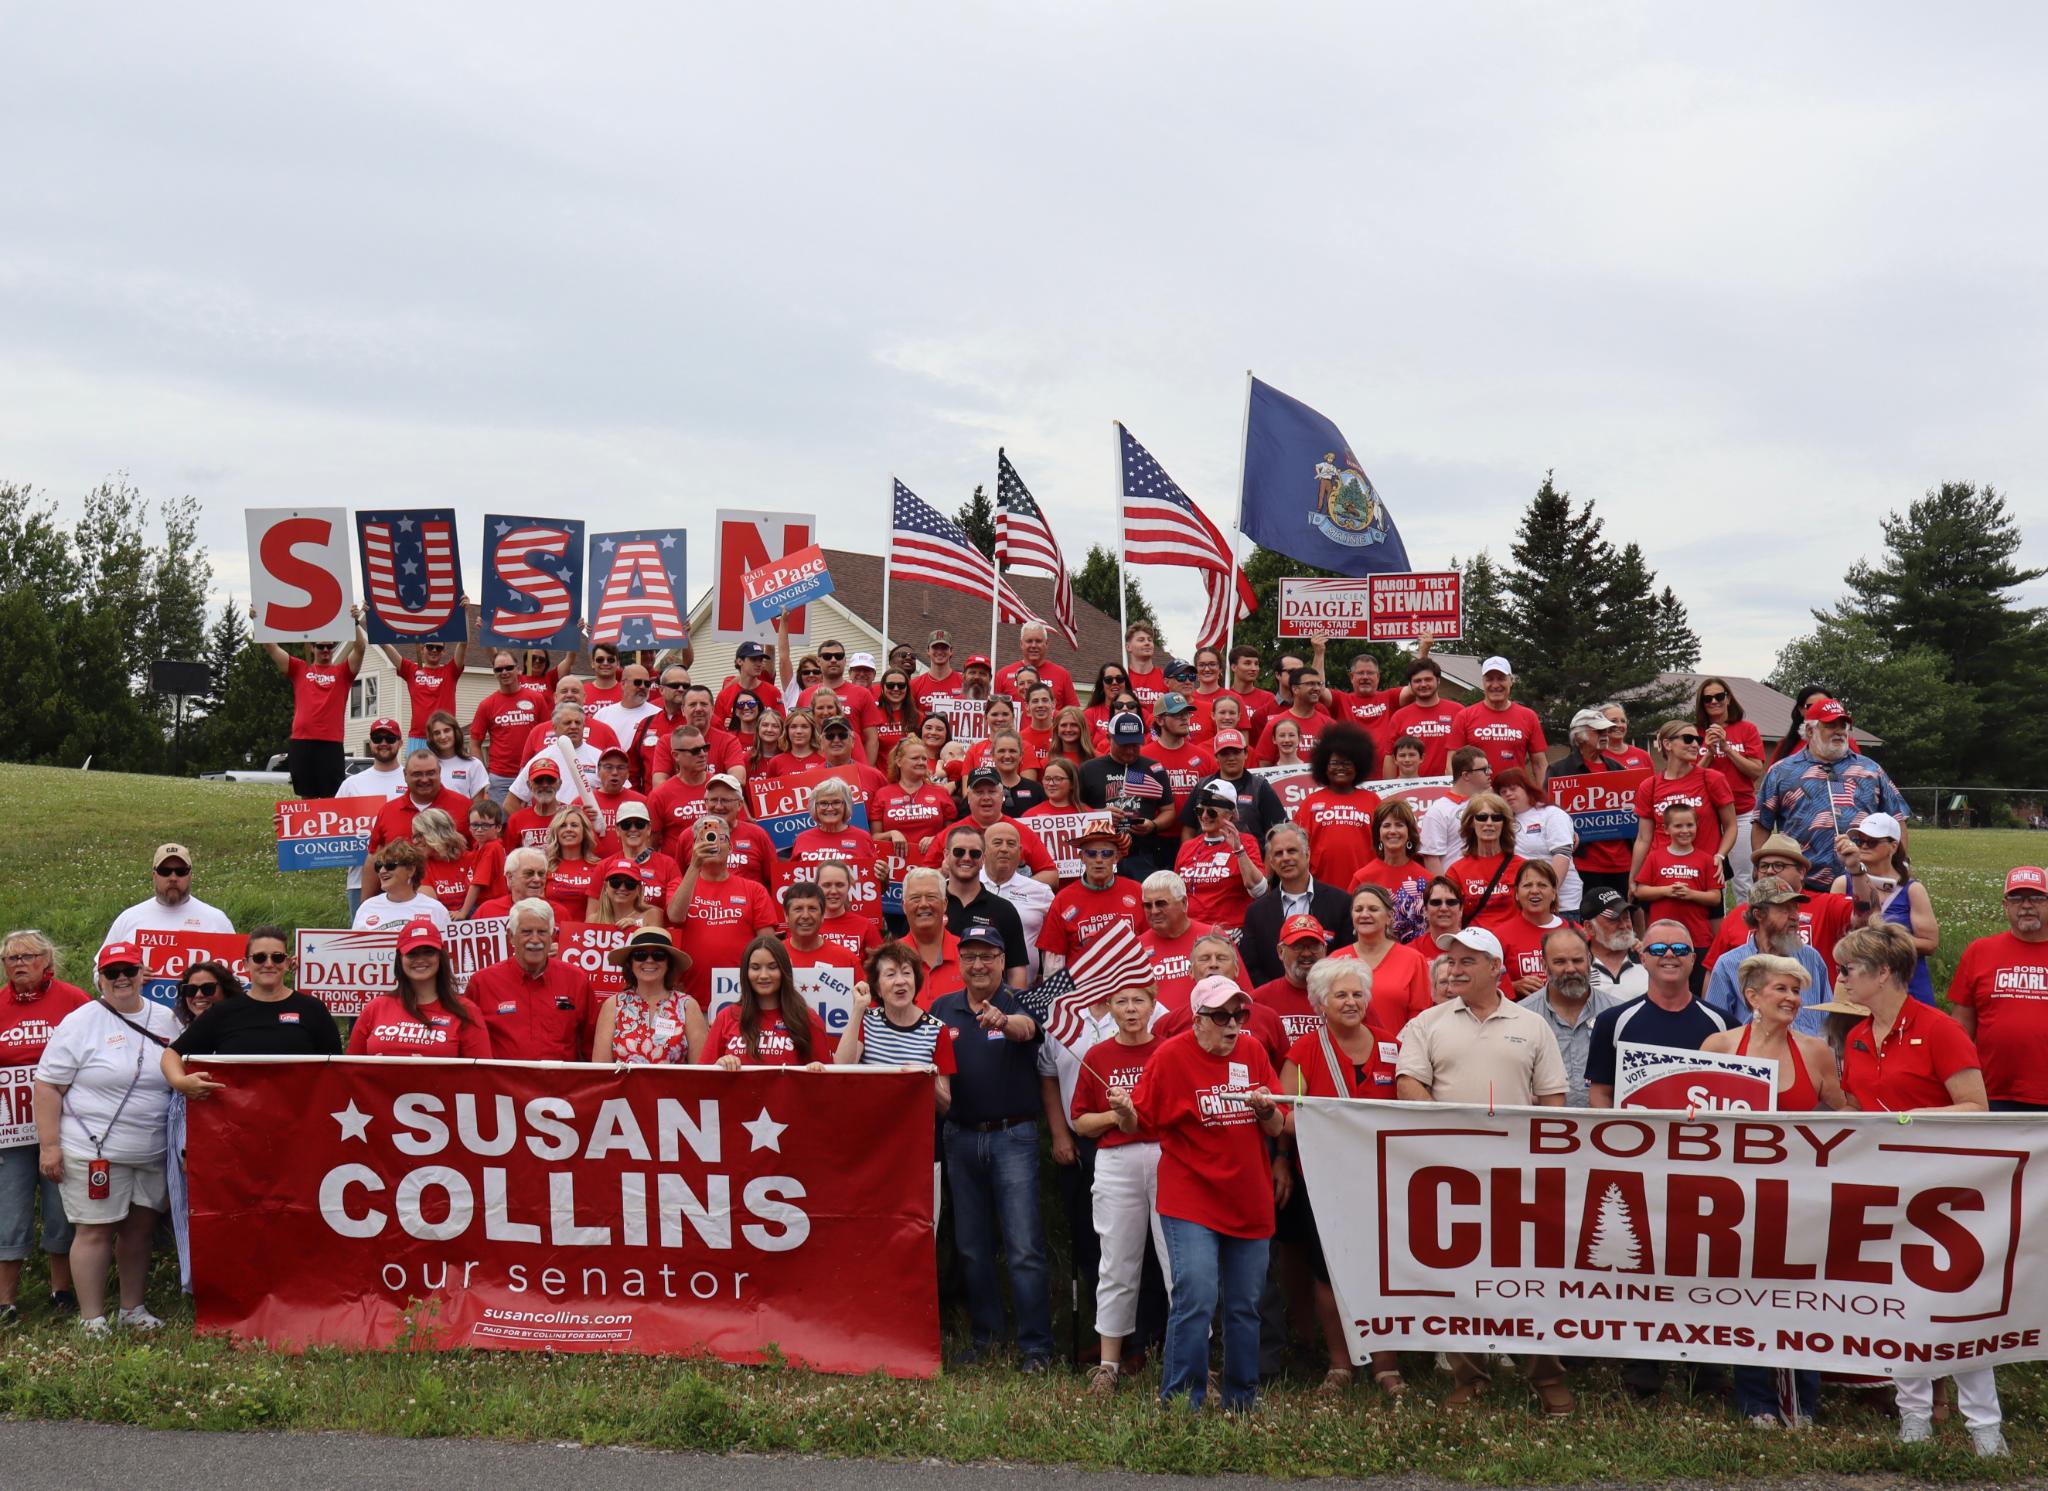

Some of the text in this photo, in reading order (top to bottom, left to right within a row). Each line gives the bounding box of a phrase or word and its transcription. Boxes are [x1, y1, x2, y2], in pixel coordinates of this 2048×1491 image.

[744, 569, 765, 583] PAUL
[747, 557, 825, 600] LePage
[762, 577, 820, 608] CONGRESS
[1374, 579, 1416, 592] HAROLD
[1329, 592, 1366, 600] LUCIEN
[1373, 590, 1456, 613] STEWART
[1285, 600, 1363, 617] DAIGLE
[1290, 620, 1357, 630] STRONG, STABLE
[1373, 620, 1457, 636] STATE SENATE
[495, 713, 535, 725] COLLINS
[1405, 724, 1451, 735] COLLINS
[1473, 727, 1523, 740] COLLINS
[573, 758, 591, 793] COLLINS
[755, 781, 784, 794] PAUL
[1552, 779, 1580, 791] PAUL
[756, 784, 861, 818] LePe
[1554, 786, 1637, 813] LePag
[281, 804, 310, 814] PAUL
[673, 804, 706, 818] COLL
[887, 806, 939, 819] COLLINS
[1315, 806, 1370, 825] COLLINS
[281, 811, 378, 839] LePag
[774, 816, 818, 834] CONG
[1031, 815, 1086, 830] BOBBY
[1337, 819, 1363, 828] senator
[1574, 813, 1639, 830] ONGRESS
[1660, 867, 1699, 878] COLLINS
[2012, 872, 2041, 882] CHARLES
[694, 896, 722, 906] Susan
[687, 903, 744, 921] Collins
[446, 919, 511, 938] BOBBY
[140, 934, 178, 947] PAUL
[304, 962, 398, 986] DAIGL
[1998, 973, 2048, 990] CHARL
[818, 971, 851, 996] ELECT
[312, 990, 365, 1003] STRONG,
[22, 1019, 46, 1027] SUSAN
[374, 1024, 447, 1043] COLLINS
[398, 1036, 435, 1046] senator
[1121, 1066, 1144, 1074] LUCIE
[1625, 1067, 1648, 1085] VOTE
[391, 1092, 722, 1163] SUSAN
[1528, 1119, 1858, 1168] BOBBY
[318, 1163, 811, 1253] COLLINS
[1406, 1164, 1986, 1294] CHARLES
[382, 1261, 751, 1299] our senator
[1475, 1279, 1906, 1320] FOR MAINE GOVERNOR
[483, 1308, 632, 1325] susancollins.com
[483, 1326, 502, 1334] PAID
[503, 1329, 520, 1337] FOR
[533, 1331, 567, 1339] COLLINS
[586, 1332, 623, 1340] SENATOR
[1422, 1315, 1545, 1342] CRIME,
[1552, 1317, 1621, 1342] CUT
[1627, 1320, 1767, 1353] TAXES,
[1776, 1329, 1835, 1353] NO
[1842, 1328, 2042, 1363] NONSENSE
